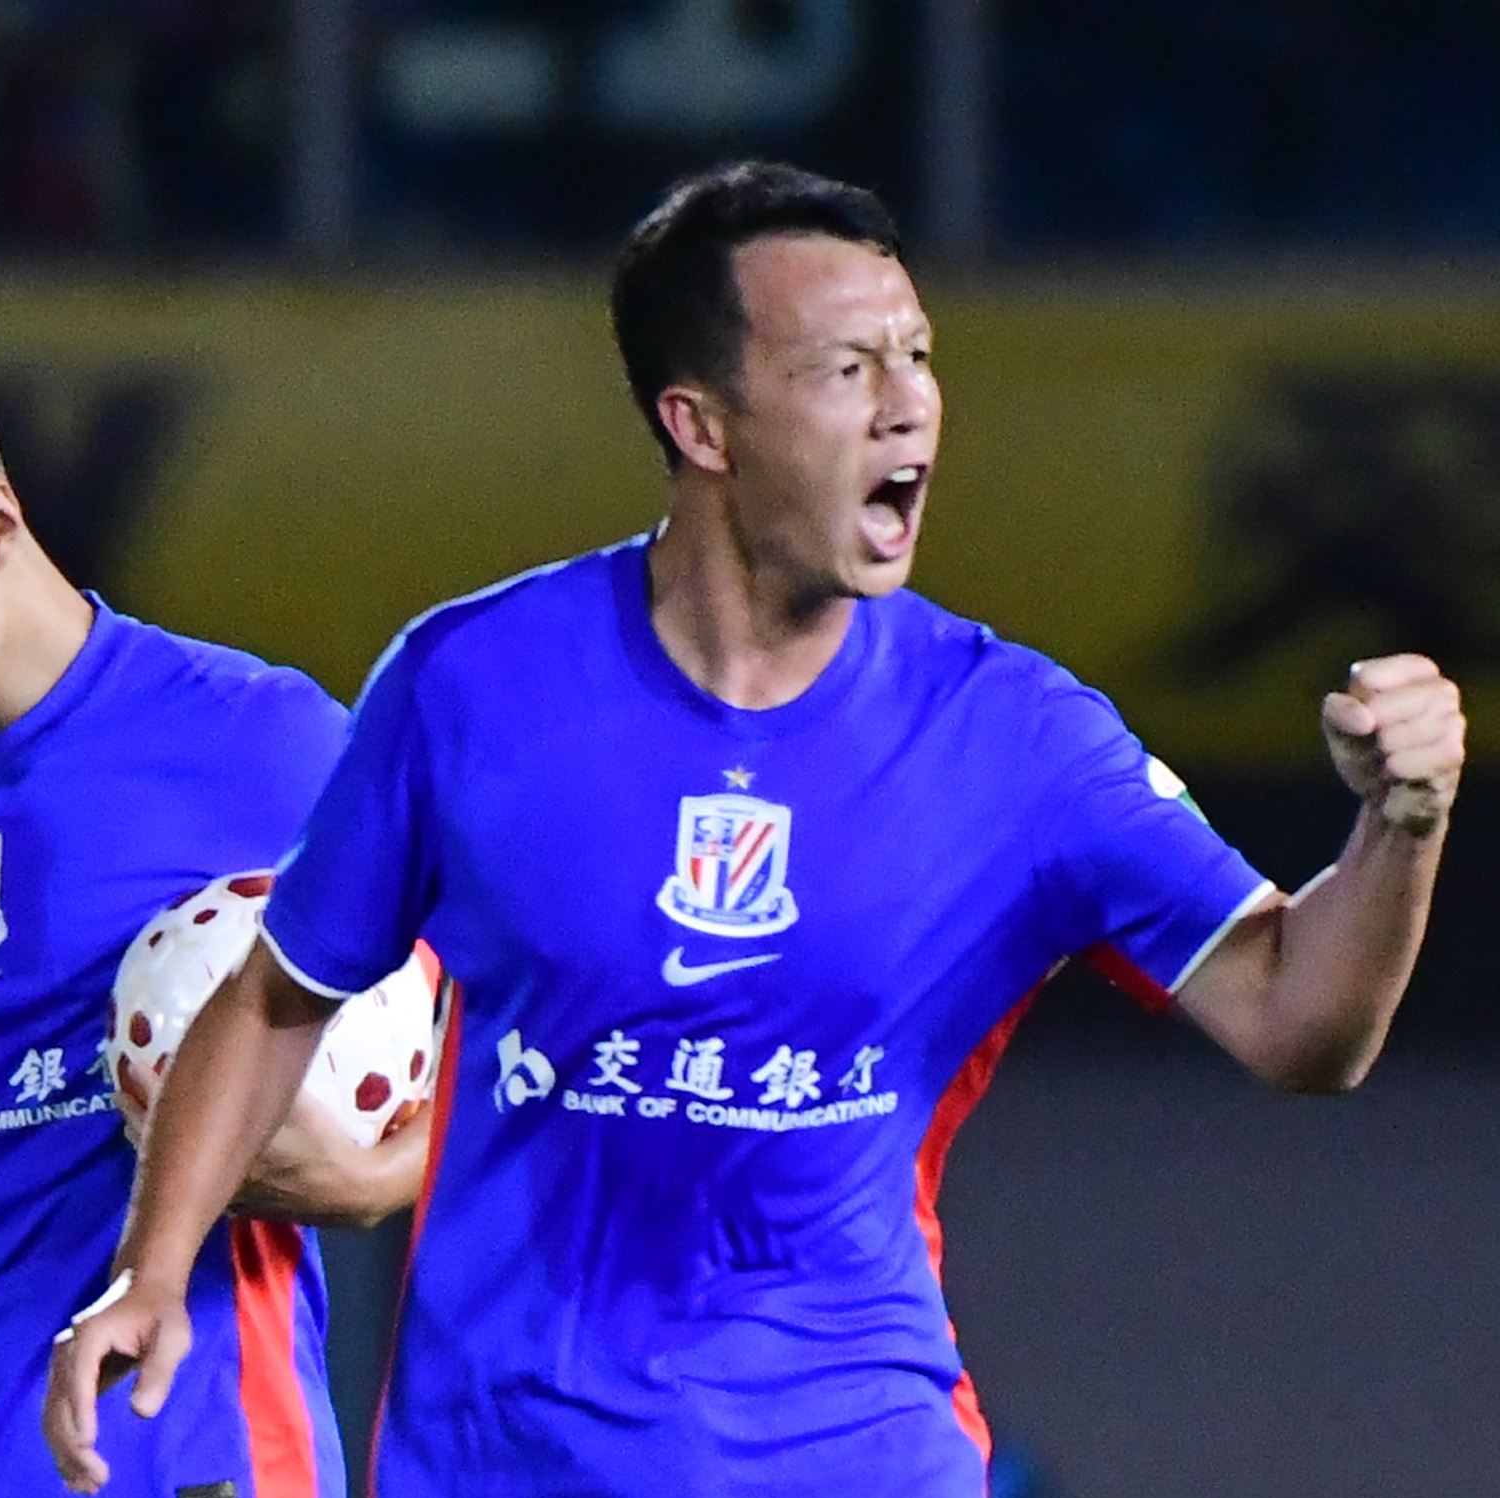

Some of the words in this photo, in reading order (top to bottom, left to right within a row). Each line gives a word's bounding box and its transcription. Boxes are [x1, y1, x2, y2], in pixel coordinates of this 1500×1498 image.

[563, 1090, 626, 1117] BANK
[637, 1096, 677, 1119] OF
[686, 1091, 898, 1132] COMMUNICATIONS
